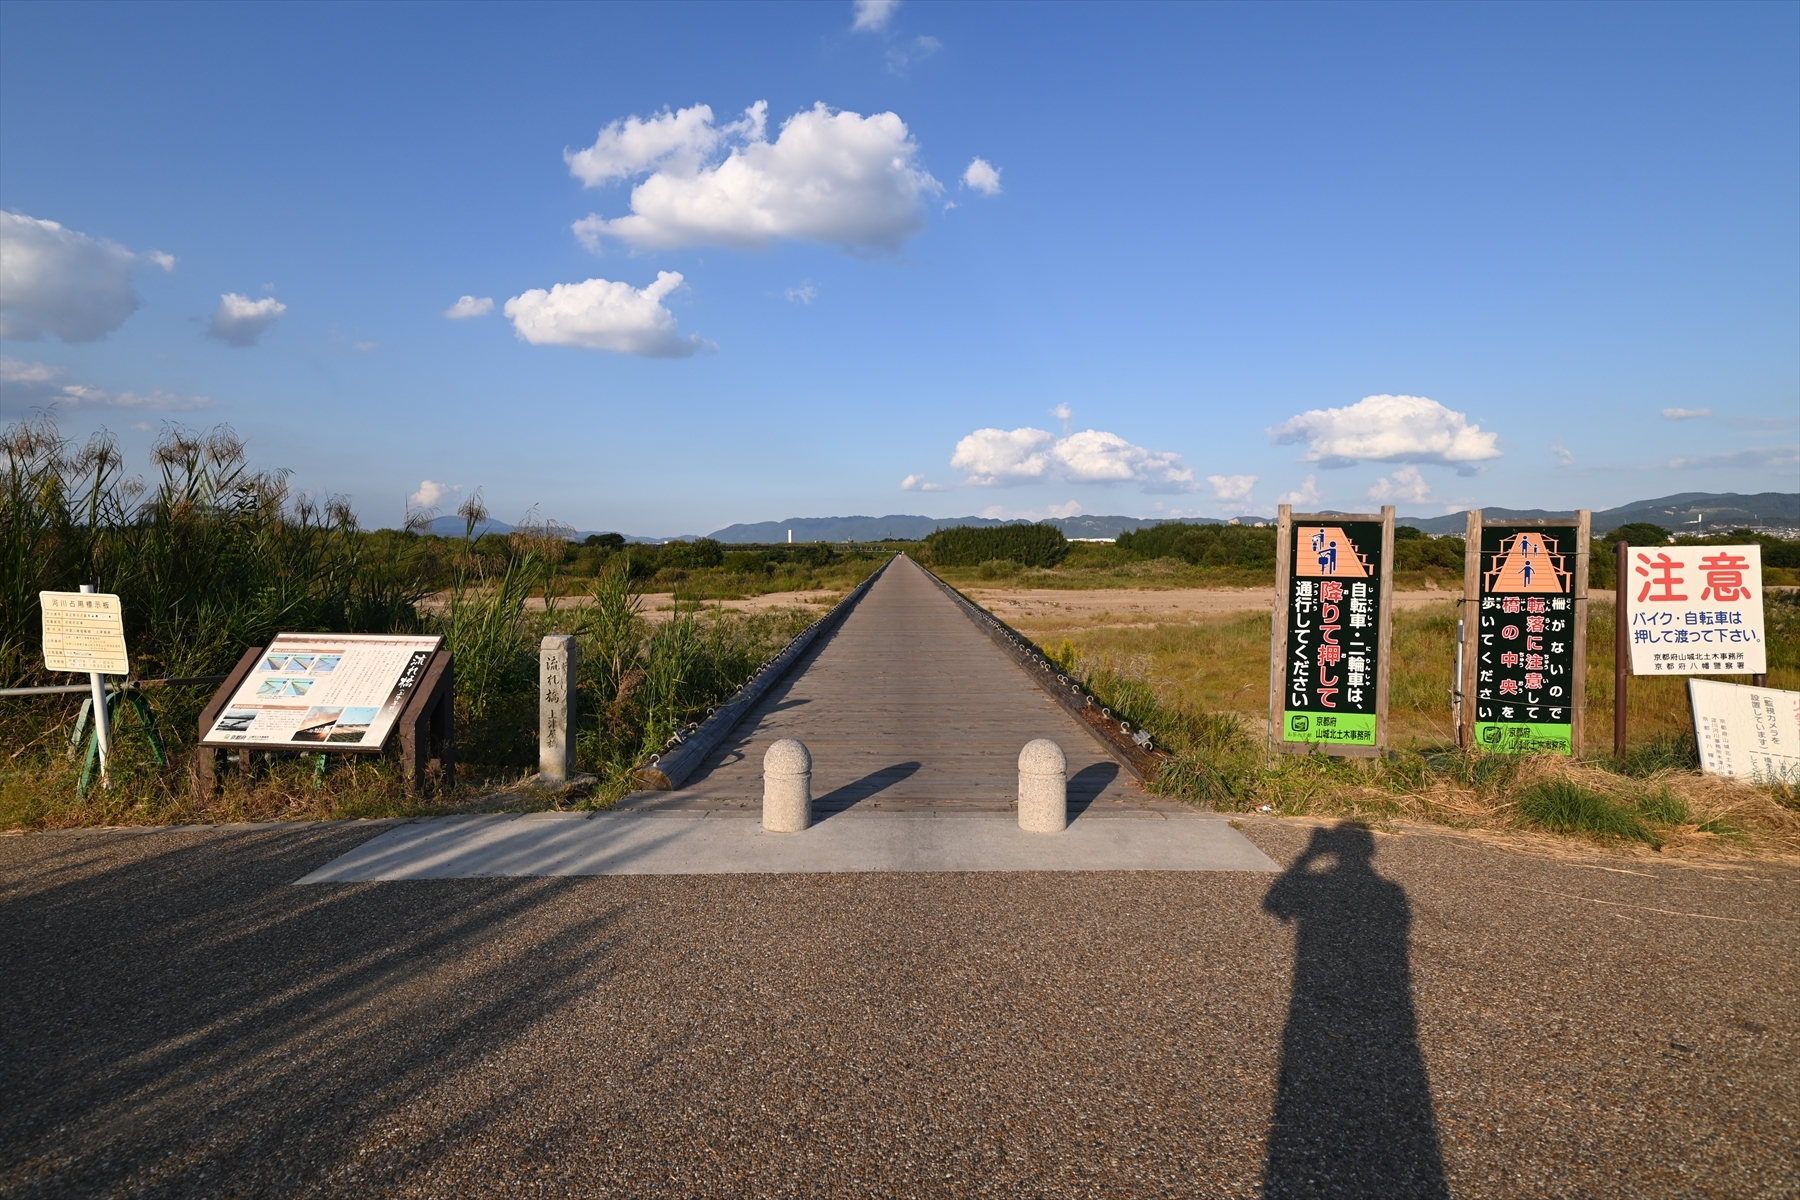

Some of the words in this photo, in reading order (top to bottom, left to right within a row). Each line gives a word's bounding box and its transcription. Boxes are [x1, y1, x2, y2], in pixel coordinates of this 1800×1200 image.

[1635, 551, 1751, 602] 注意
[1633, 611, 1742, 625] バイク・自転車は
[1634, 629, 1761, 644] 押して渡って下さい。
[1292, 581, 1312, 707] 通行してください
[1317, 581, 1343, 708] 降りて押して
[1479, 597, 1495, 718] 歩いてください
[1499, 596, 1520, 719] 橋の中央を
[1525, 596, 1545, 719] 転落に注意して
[1549, 597, 1566, 719] 柵がないので
[1653, 652, 1744, 661] 京都府山城北土木事務所
[1654, 662, 1745, 670] 京都府八幡警察署
[545, 656, 560, 703] 流れ橋
[1315, 729, 1371, 741] 山城北土木事務所
[1316, 716, 1337, 727] 京都府
